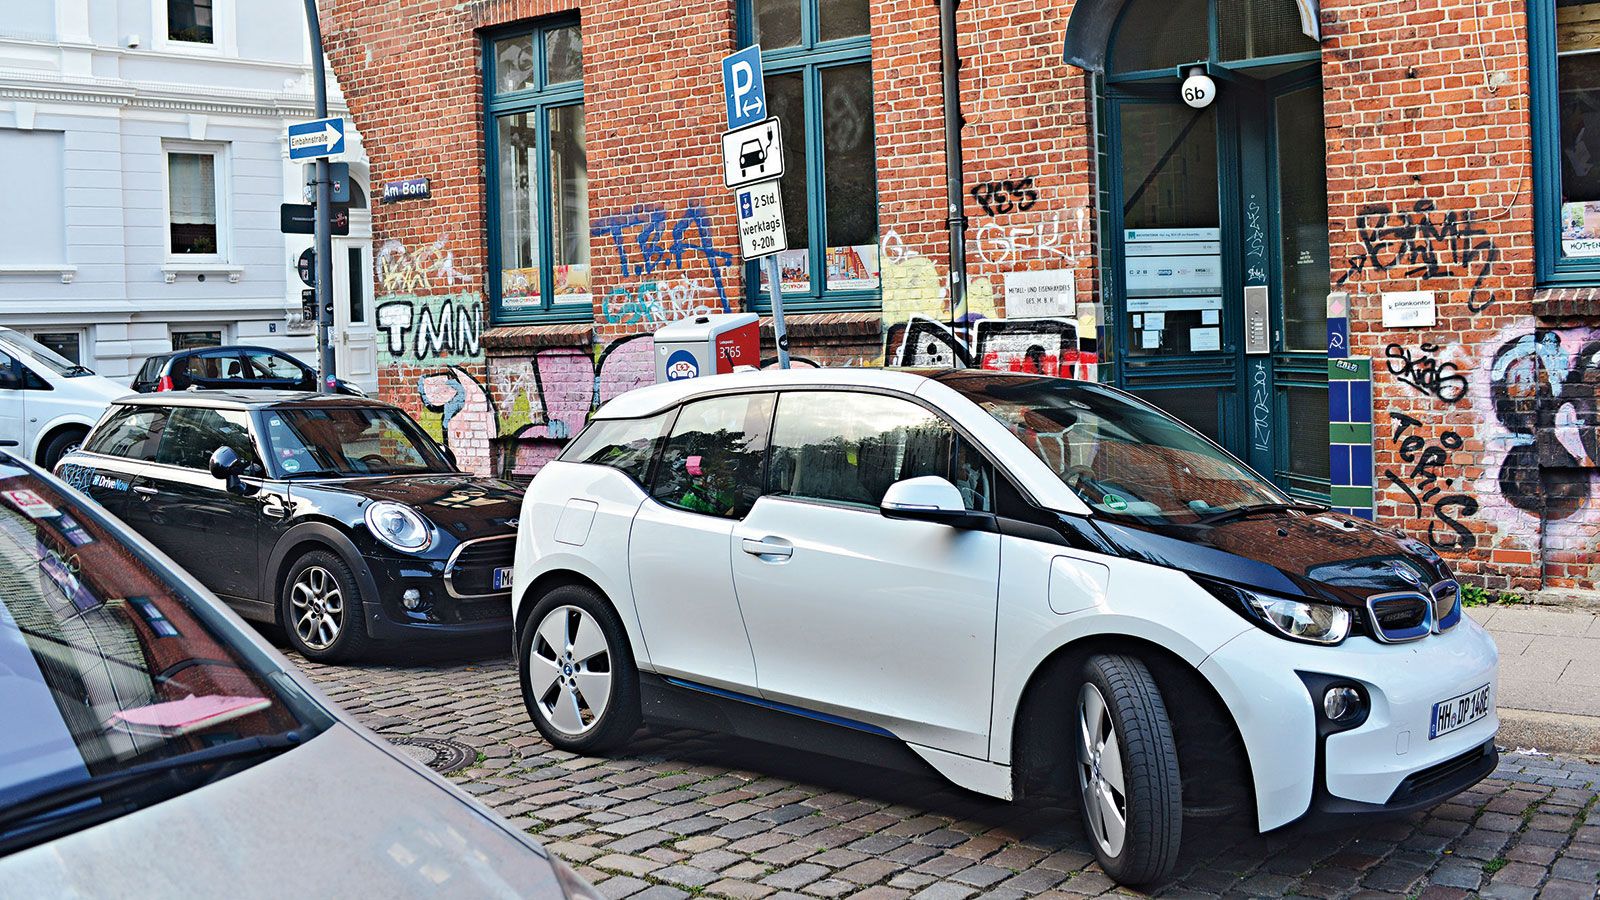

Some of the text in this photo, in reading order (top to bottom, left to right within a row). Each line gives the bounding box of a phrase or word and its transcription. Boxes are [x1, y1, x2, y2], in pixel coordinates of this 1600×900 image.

[732, 60, 753, 119] P
[1185, 86, 1205, 102] 6b
[291, 133, 328, 147] Einbahnstraße
[384, 181, 427, 197] Am Born
[754, 192, 777, 209] 2 Std.
[742, 218, 781, 236] werktags
[752, 235, 775, 251] 9-20h
[1027, 286, 1037, 294] UND
[1394, 300, 1431, 308] plankontor
[375, 298, 481, 361] TMN
[719, 345, 741, 359] 3765
[1437, 703, 1452, 732] HH
[1457, 697, 1470, 725] DP
